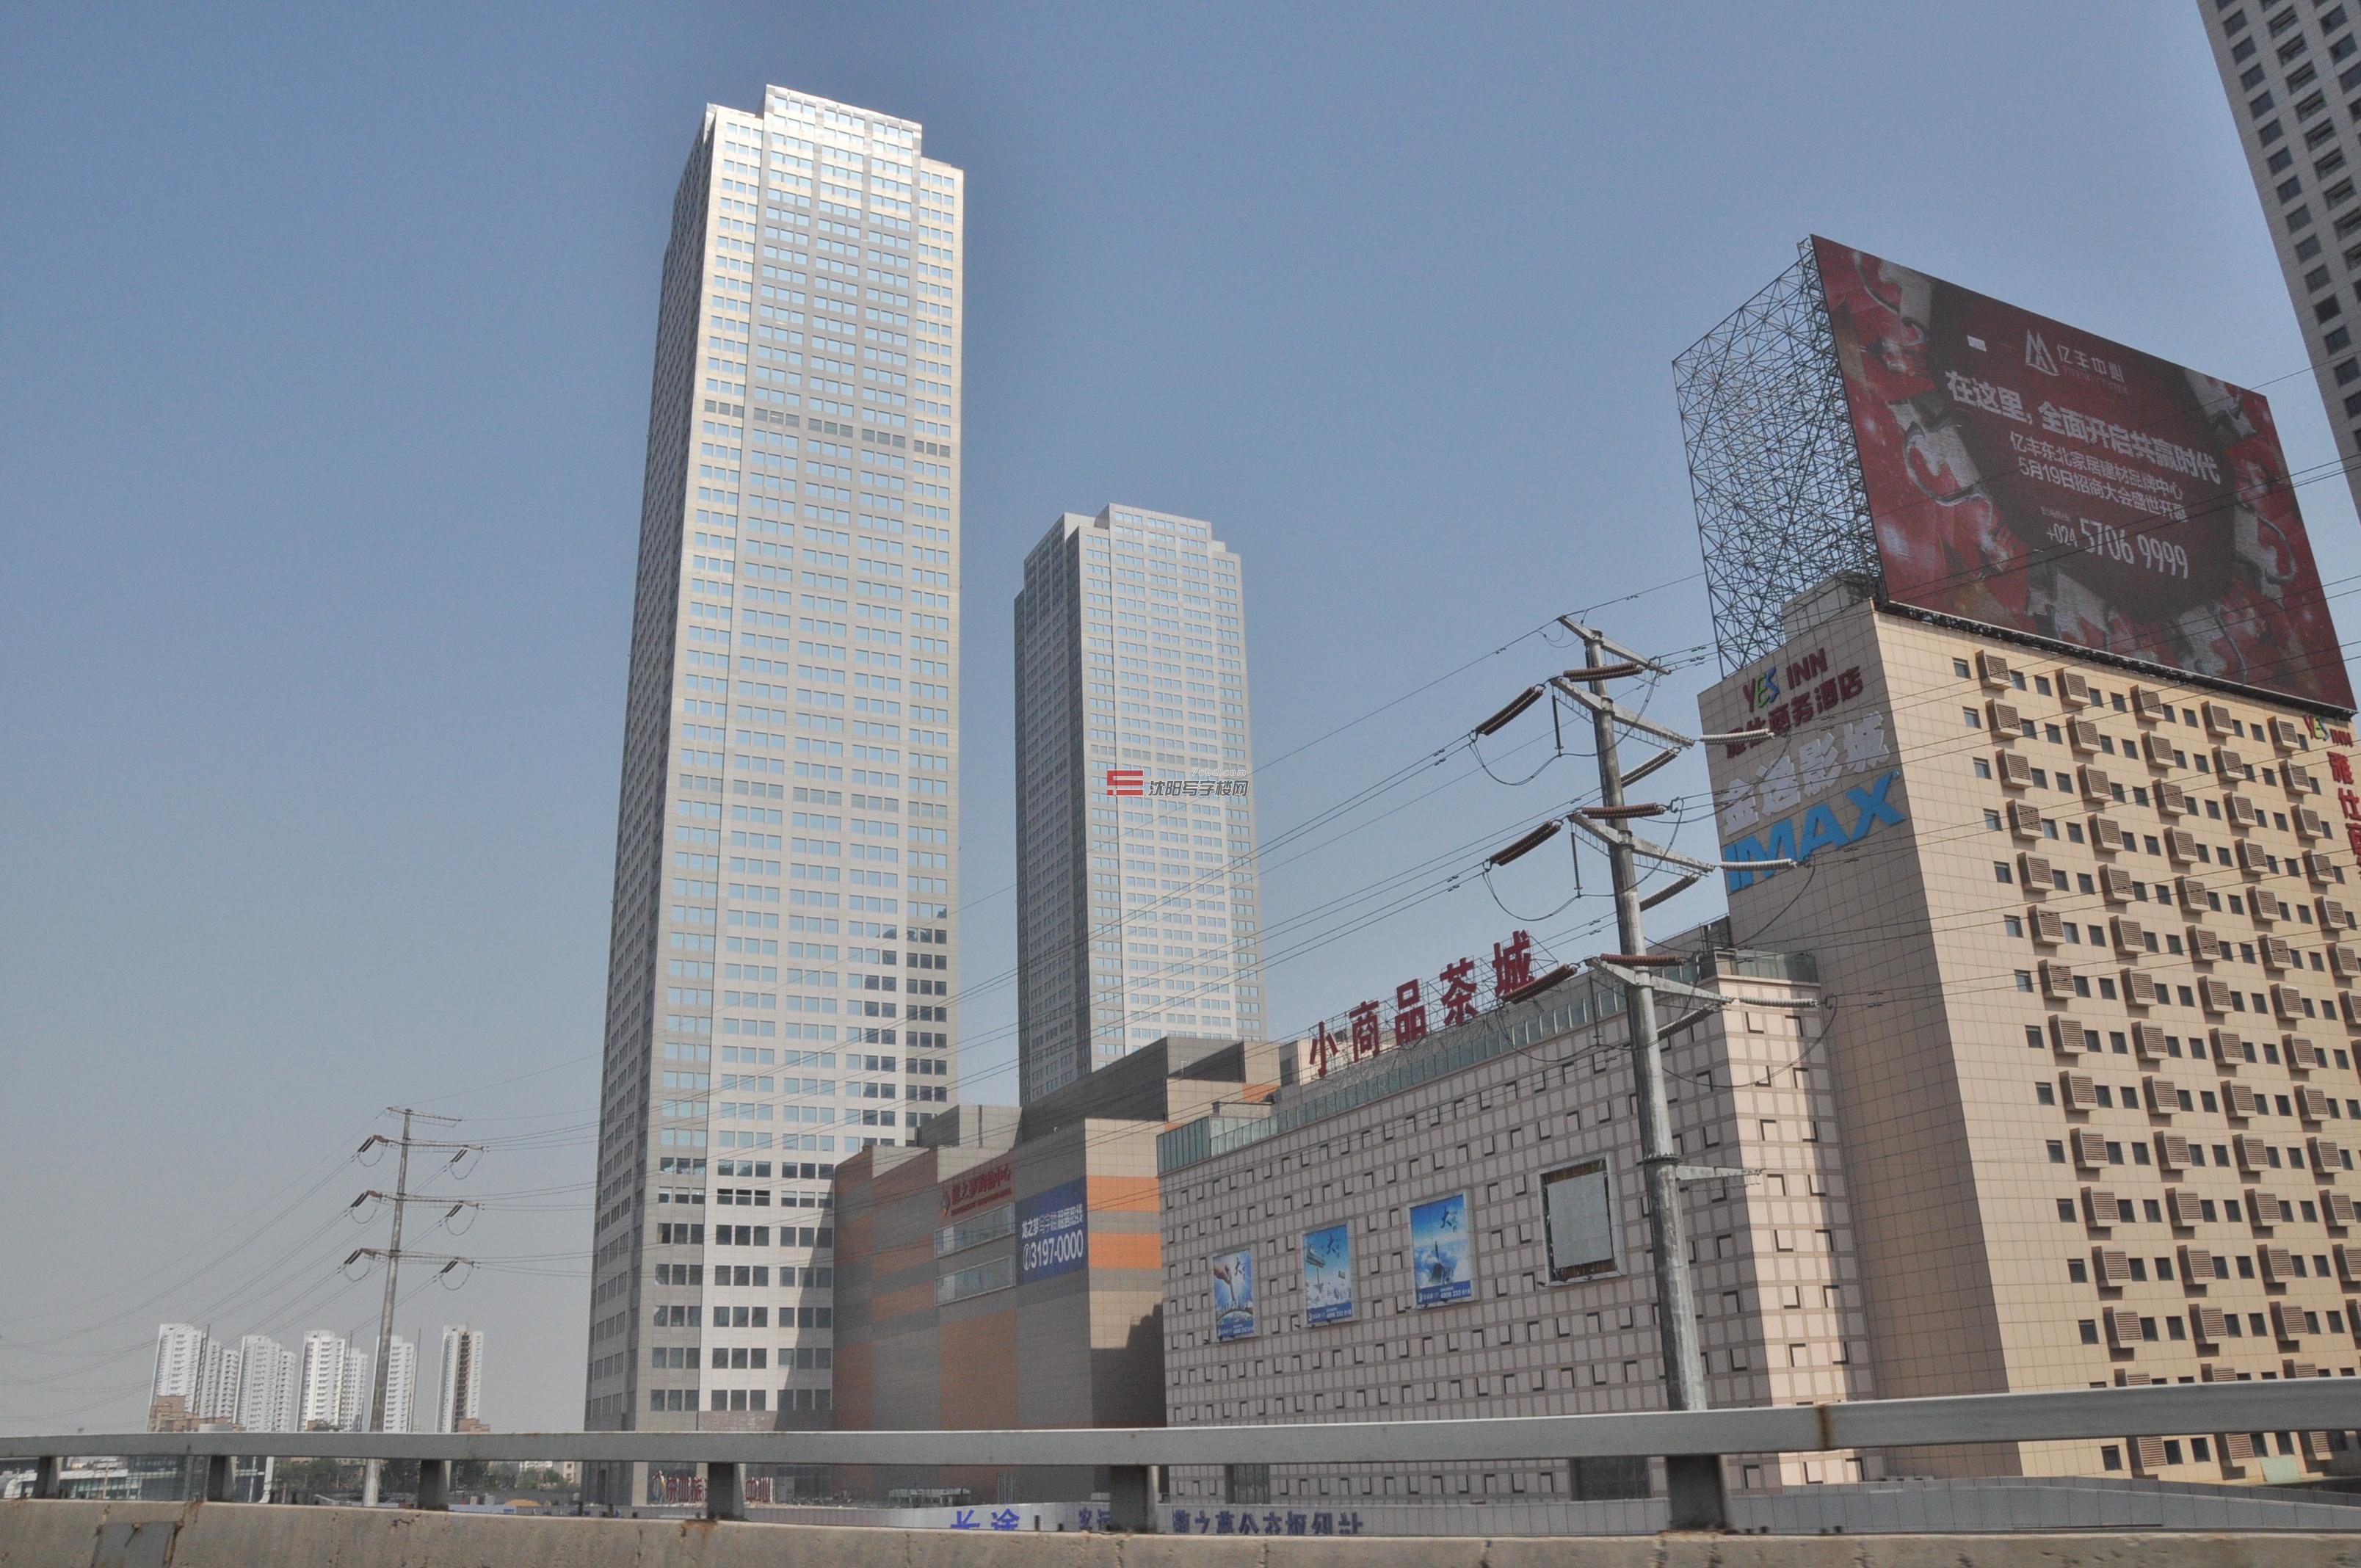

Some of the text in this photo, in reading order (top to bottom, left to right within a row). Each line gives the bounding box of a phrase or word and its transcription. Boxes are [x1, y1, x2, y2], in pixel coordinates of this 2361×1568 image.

[2056, 343, 2125, 382] 亿丰中心
[2009, 430, 2183, 501] 亿丰东北家居建材品牌中心
[2018, 457, 2188, 523] 5月19日招商大会盛世开幕
[2079, 517, 2135, 565] 5706
[2137, 534, 2188, 579] 9999
[1743, 648, 1828, 713] YES INN
[2303, 714, 2331, 742] YES
[1723, 771, 1907, 893] IMAX
[1308, 929, 1535, 1079] 小商品茶城
